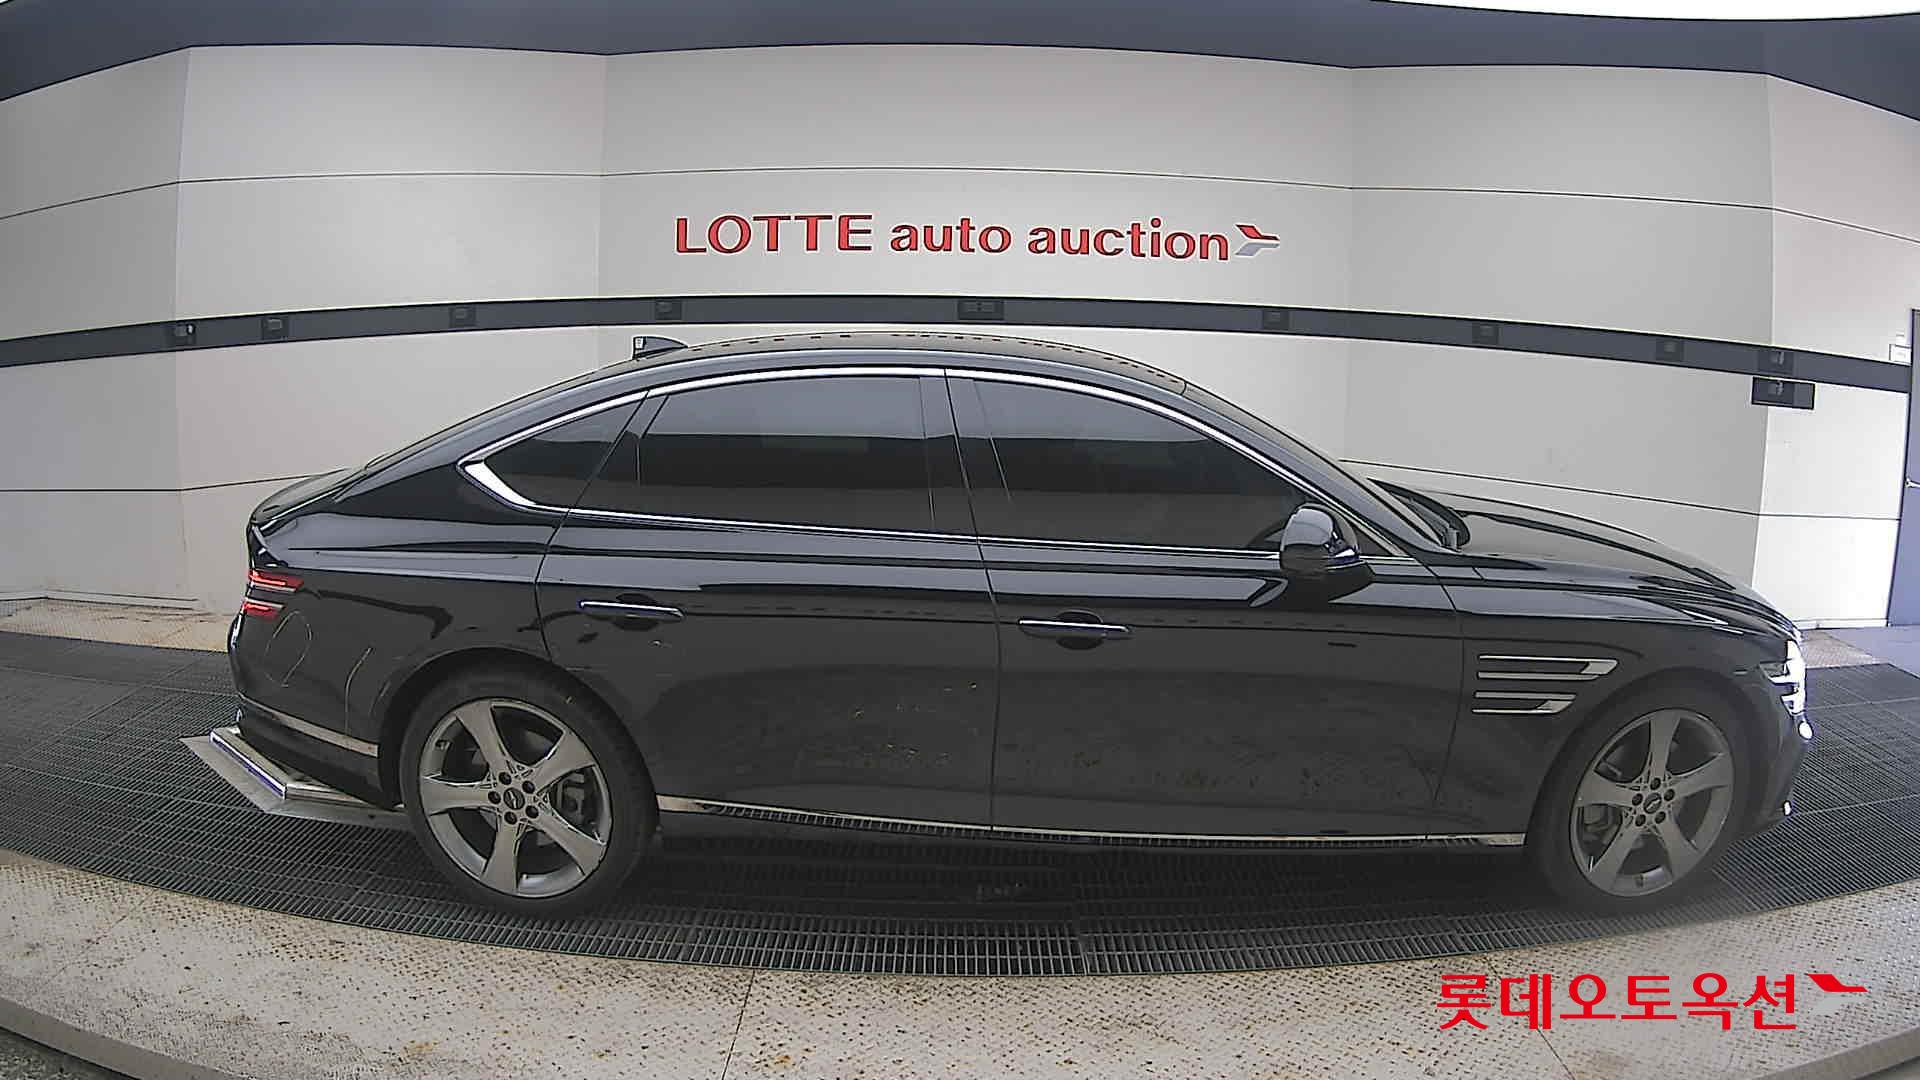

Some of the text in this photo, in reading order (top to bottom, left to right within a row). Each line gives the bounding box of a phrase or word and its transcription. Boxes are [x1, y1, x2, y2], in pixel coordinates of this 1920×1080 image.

[675, 214, 1229, 261] LOTTE auto auction
